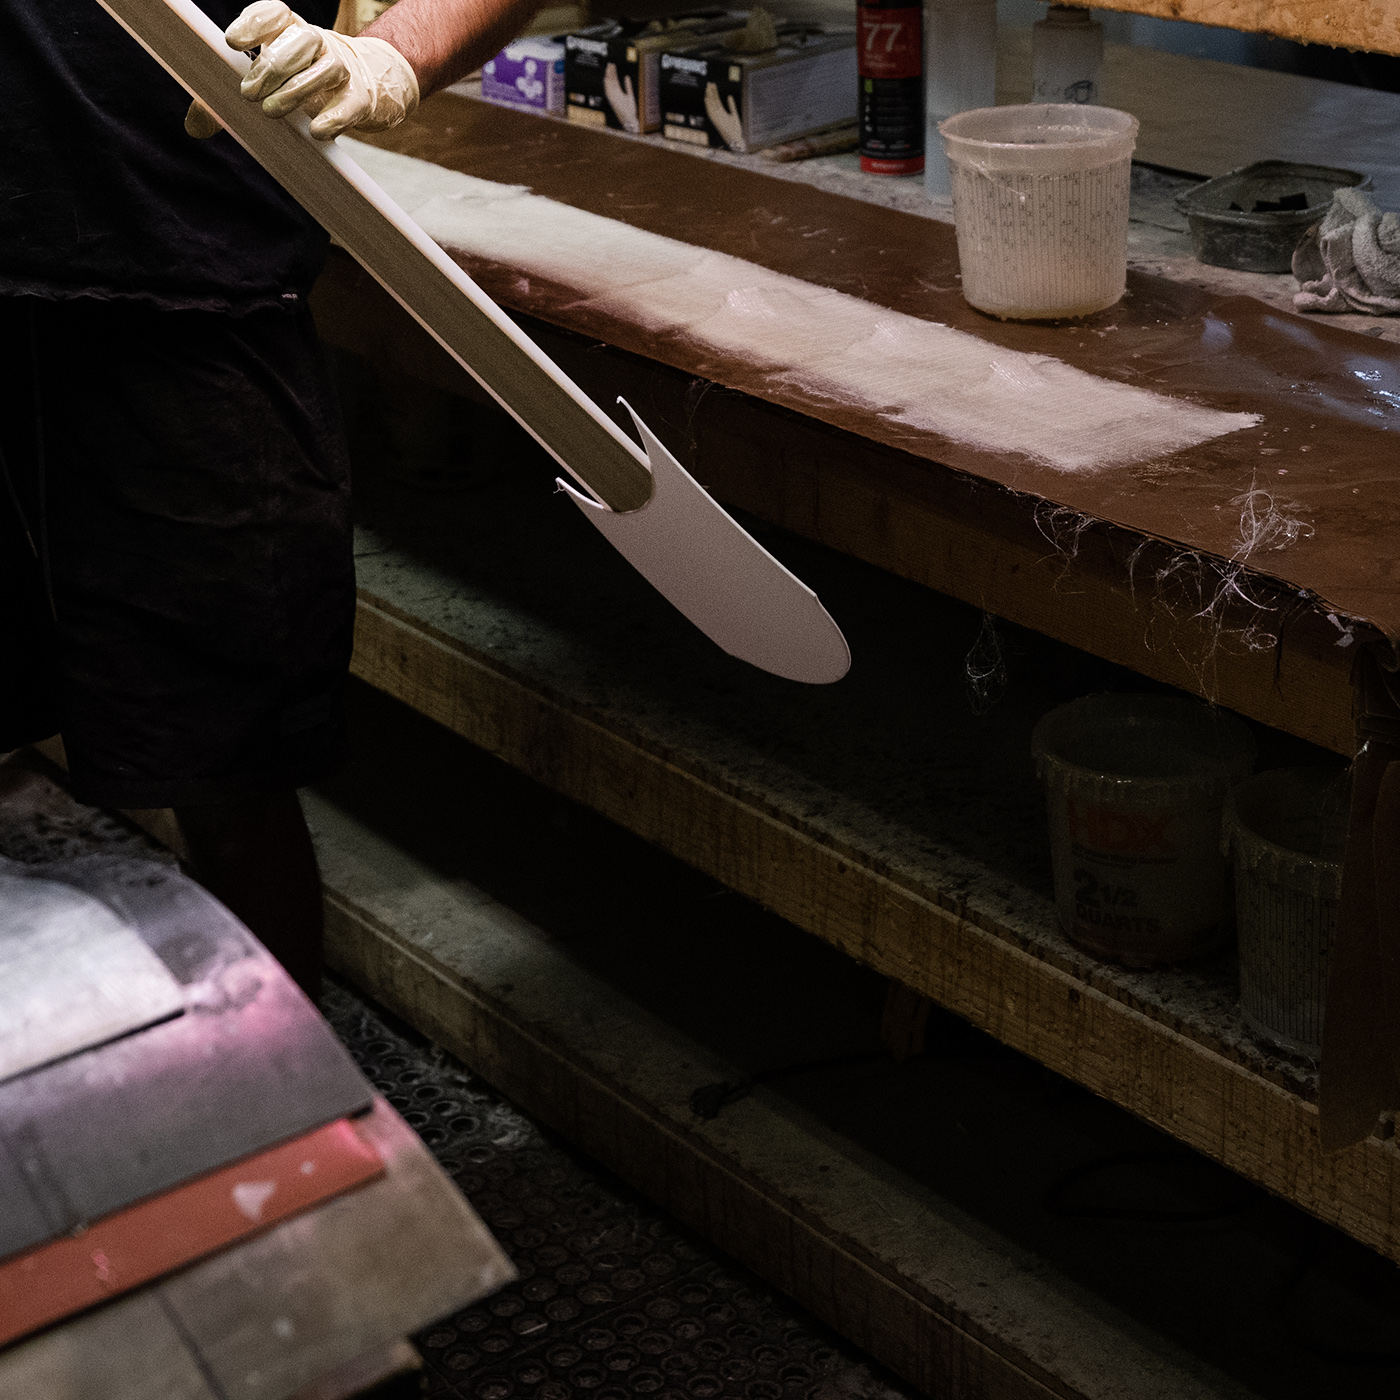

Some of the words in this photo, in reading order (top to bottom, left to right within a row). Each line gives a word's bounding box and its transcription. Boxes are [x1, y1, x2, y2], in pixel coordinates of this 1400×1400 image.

[863, 22, 902, 53] 77
[1068, 800, 1174, 851] HDX
[1075, 902, 1161, 933] QUARTS
